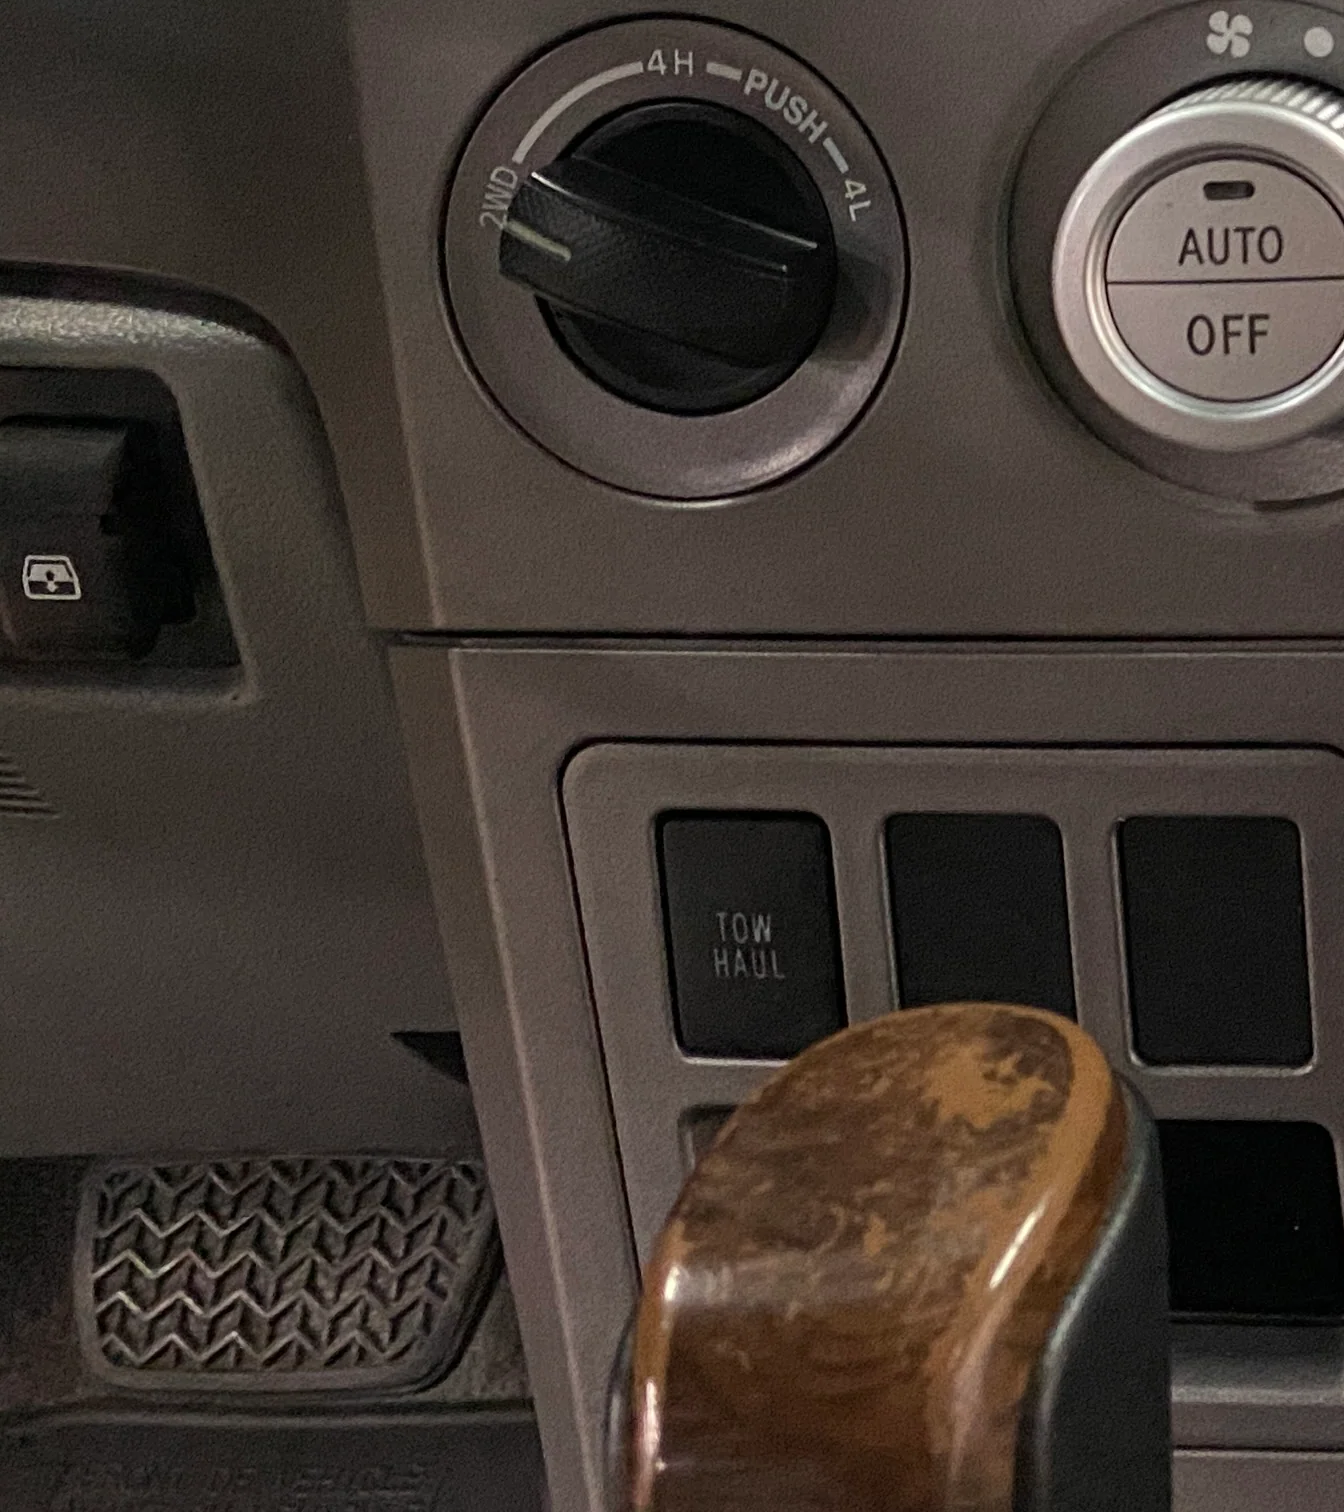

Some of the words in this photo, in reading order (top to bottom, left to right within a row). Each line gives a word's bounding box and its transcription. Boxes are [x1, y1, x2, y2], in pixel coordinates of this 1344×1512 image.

[479, 166, 518, 230] 2WD
[647, 48, 695, 77] 4H
[742, 67, 830, 146] PUSH
[843, 178, 873, 223] 4L
[1178, 225, 1284, 266] AUTO
[1186, 313, 1270, 356] OFF
[716, 912, 772, 943] TOW
[712, 947, 786, 980] HAUL
